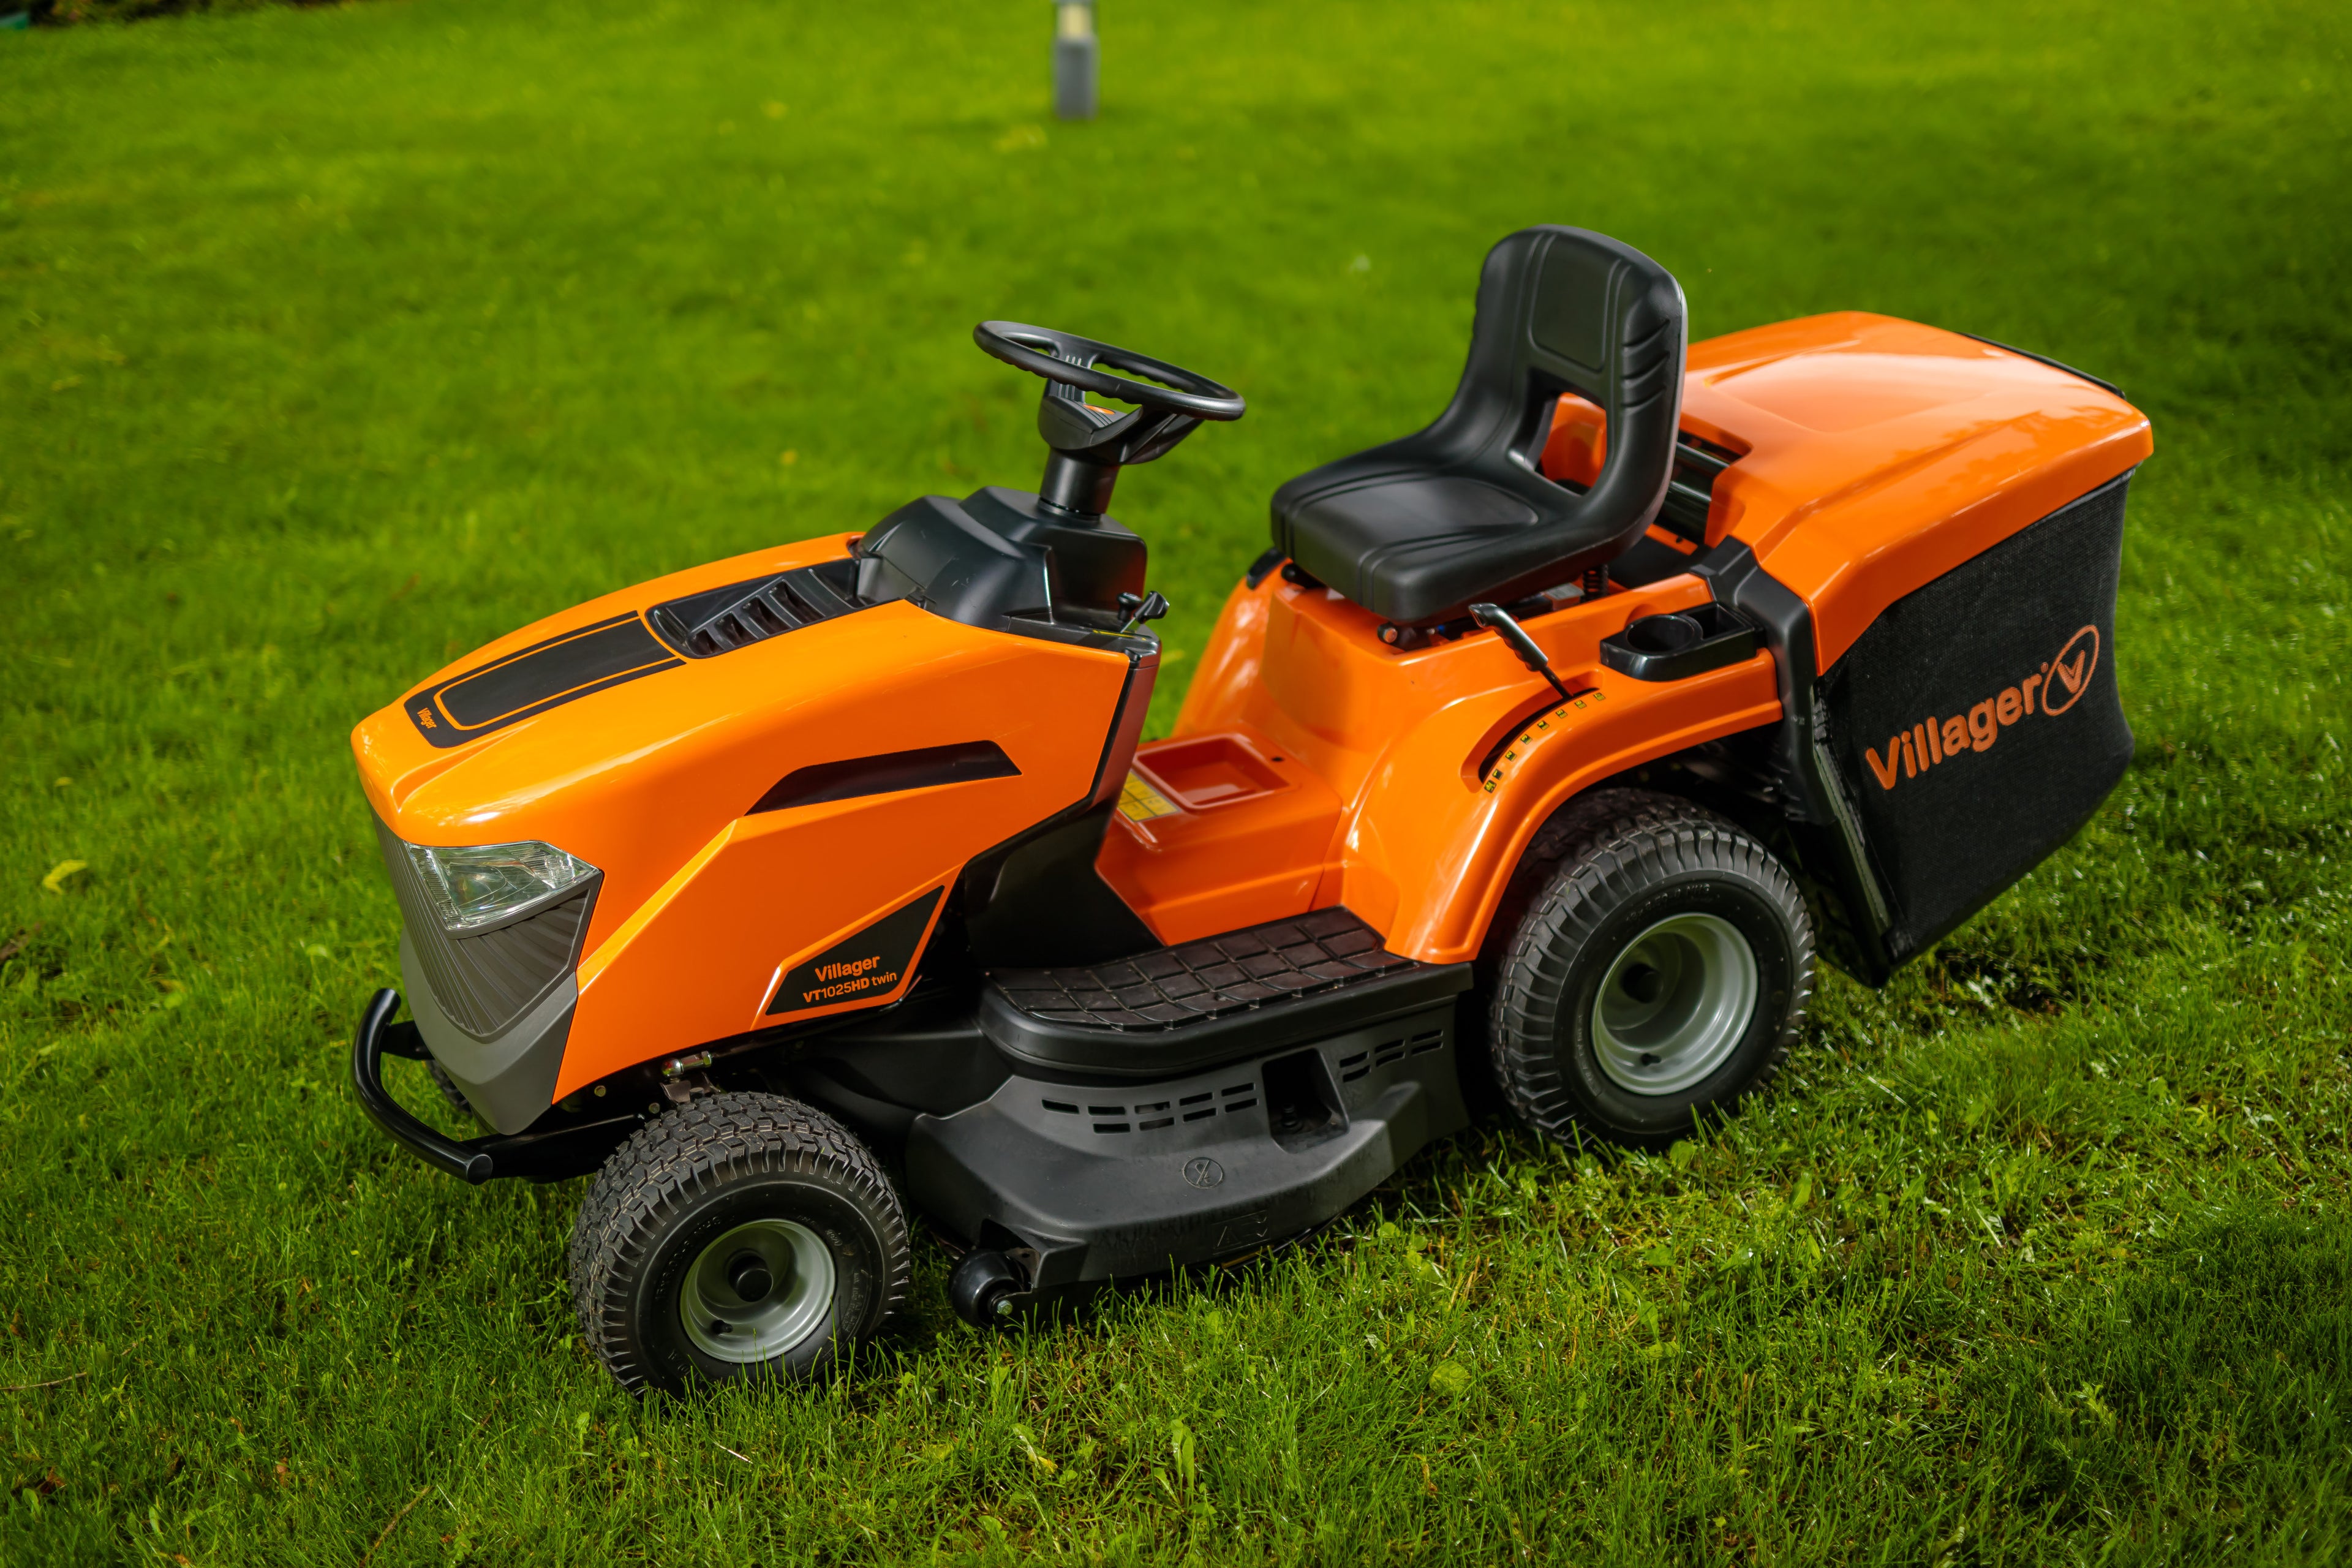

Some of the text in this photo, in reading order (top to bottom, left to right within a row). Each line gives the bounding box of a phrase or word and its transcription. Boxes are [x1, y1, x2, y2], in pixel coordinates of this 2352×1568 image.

[417, 707, 437, 728] Villager
[1865, 673, 2043, 791] Villager
[815, 956, 880, 982] Villager
[803, 971, 897, 1003] VT1025HD twin
